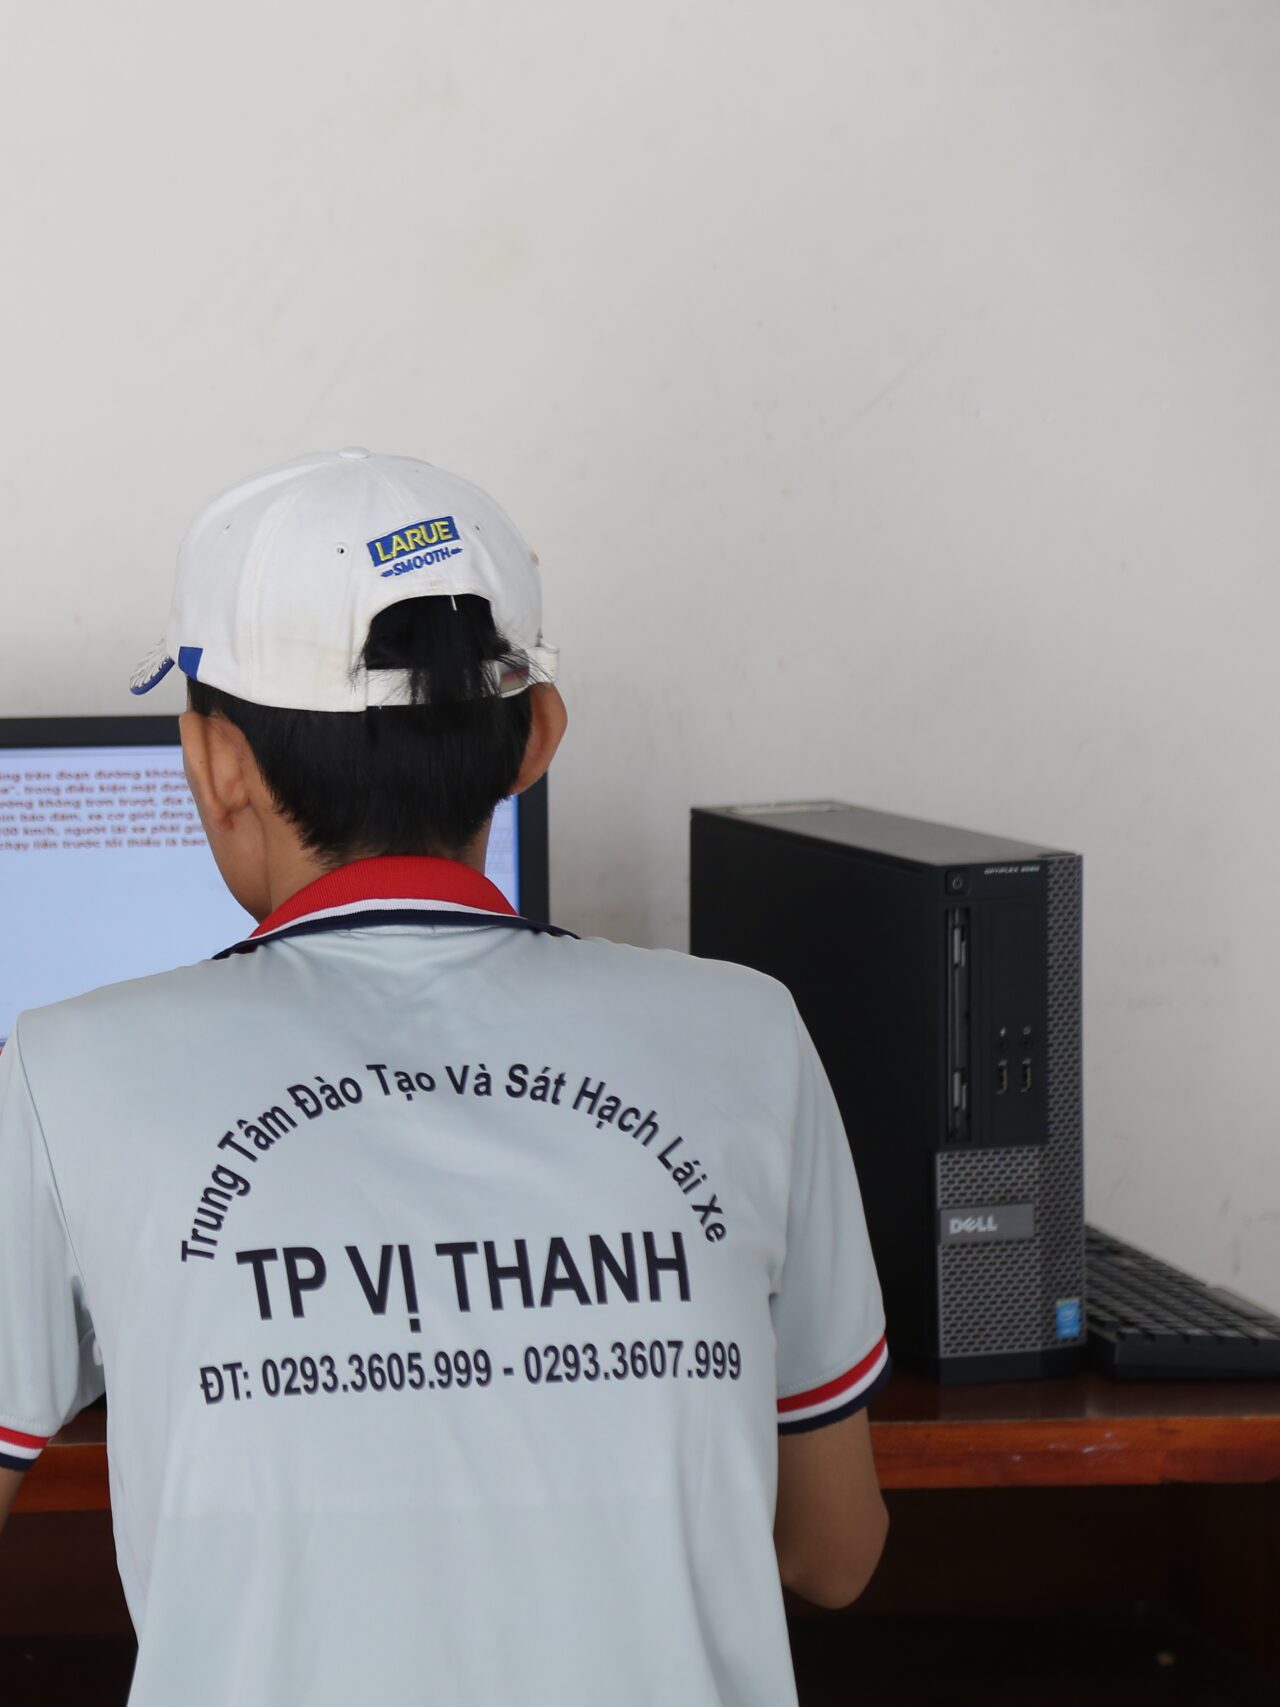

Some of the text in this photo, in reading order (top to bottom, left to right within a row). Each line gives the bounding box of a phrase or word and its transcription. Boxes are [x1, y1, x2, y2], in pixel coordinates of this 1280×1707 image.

[375, 520, 454, 562] LARUE
[392, 546, 452, 576] SMOOTH
[181, 1063, 728, 1263] Trung Tâm Đào Tạo Và Sát Hạch Lái Xe
[949, 1214, 998, 1235] DELL
[235, 1230, 692, 1333] TP VỊ THANH
[199, 1339, 742, 1405] ĐT: 0293.3605.999 - 0293.3607.999
